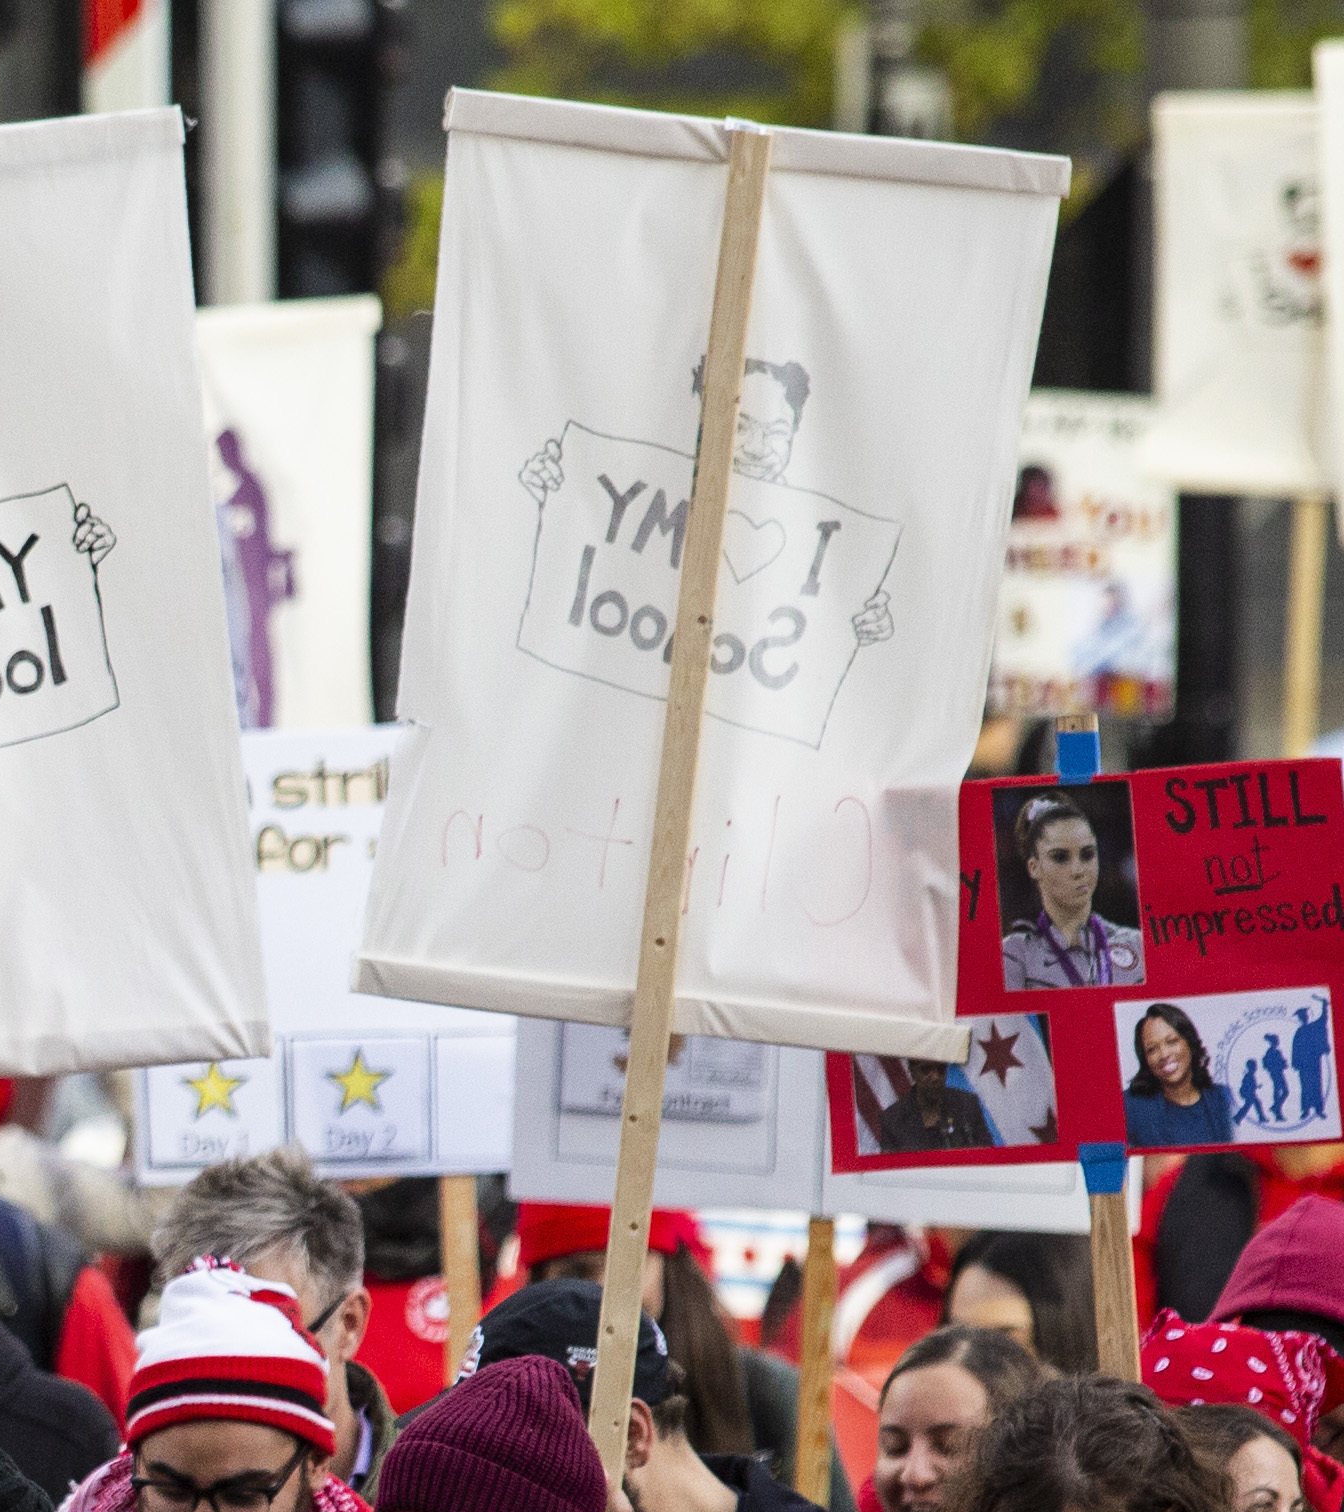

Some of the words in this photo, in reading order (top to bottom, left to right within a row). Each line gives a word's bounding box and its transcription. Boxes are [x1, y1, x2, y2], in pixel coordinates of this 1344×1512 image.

[1164, 771, 1327, 834] STILL
[1203, 836, 1281, 885] not
[1144, 883, 1344, 956] impressed
